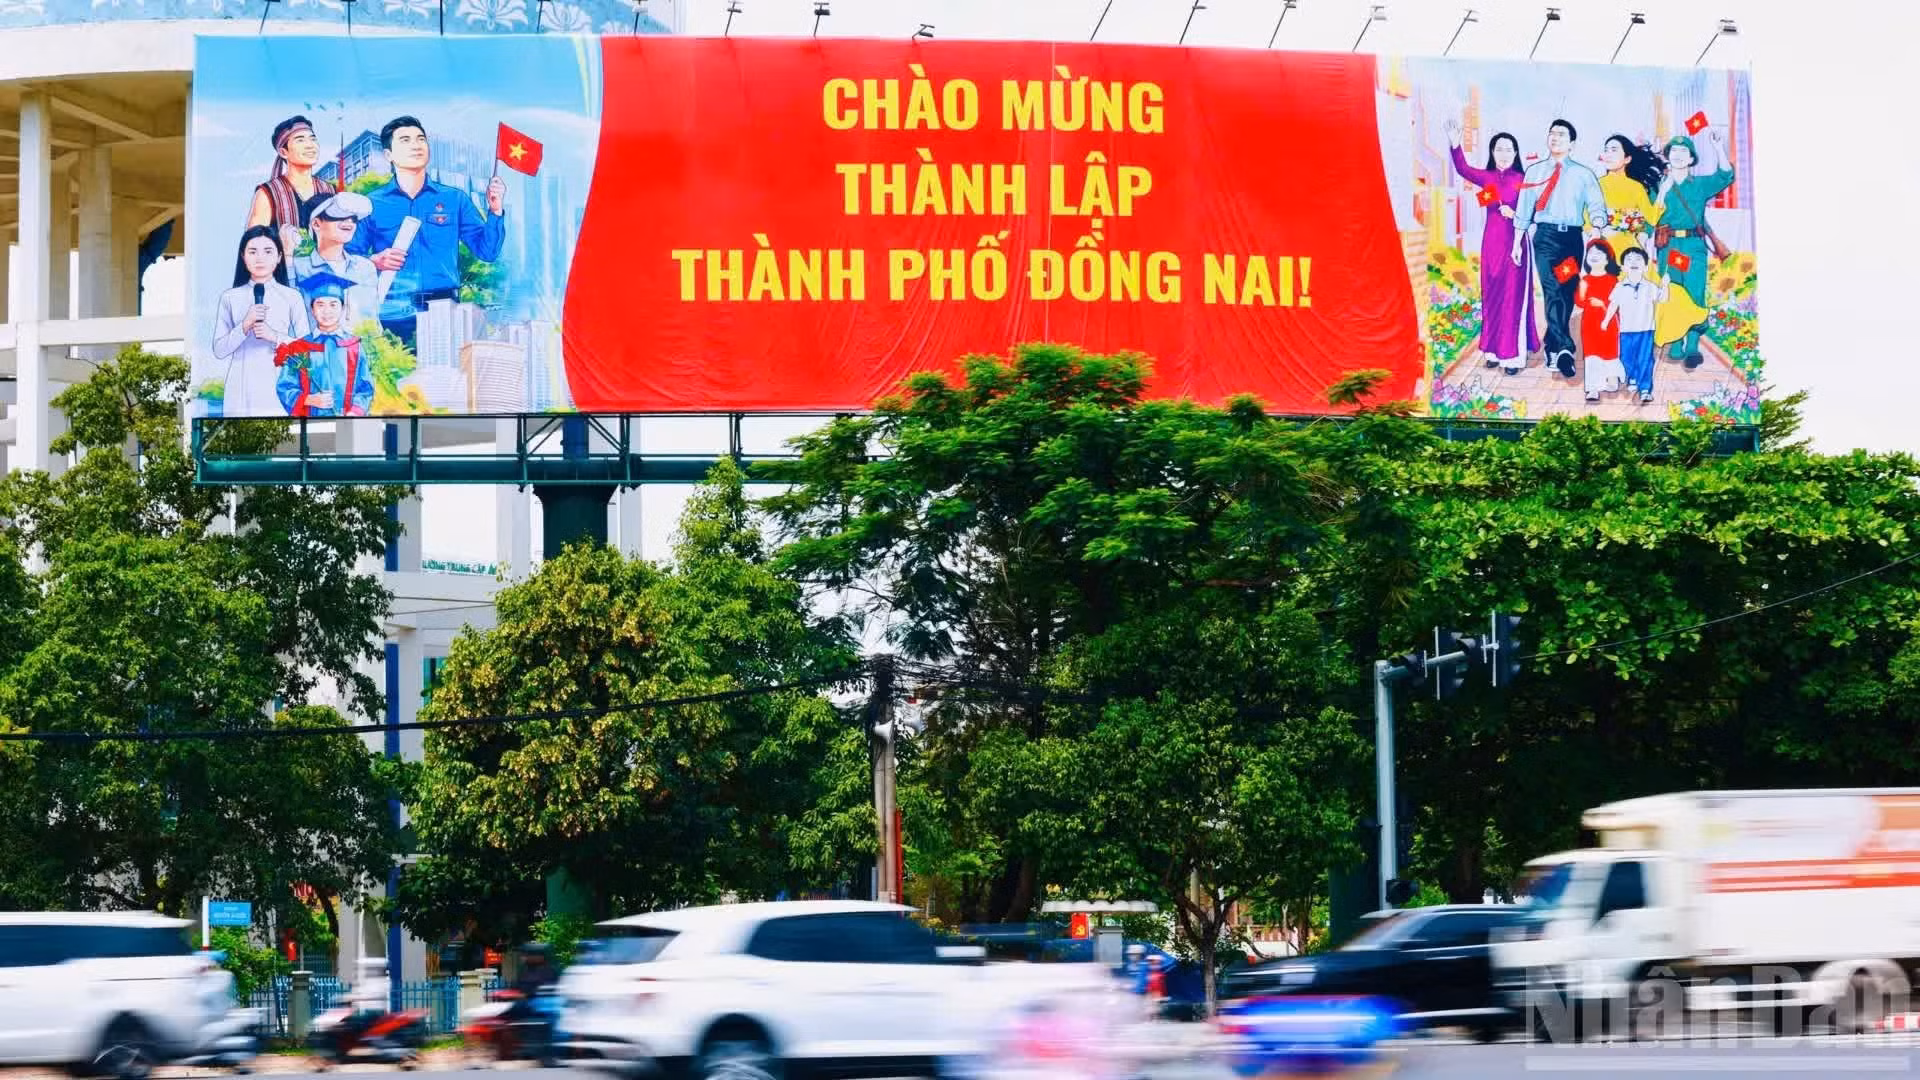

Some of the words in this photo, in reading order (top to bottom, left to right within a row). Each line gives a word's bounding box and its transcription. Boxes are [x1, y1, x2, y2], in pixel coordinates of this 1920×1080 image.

[823, 63, 979, 131] CHÀO
[1001, 64, 1164, 134] MỪNG
[835, 147, 1027, 216] THÀNH
[1049, 150, 1153, 229] LẬP
[671, 233, 866, 302] THÀNH
[888, 230, 1008, 302] PHỐ
[1026, 231, 1181, 303] ĐỒNG
[1203, 253, 1312, 308] NAI!
